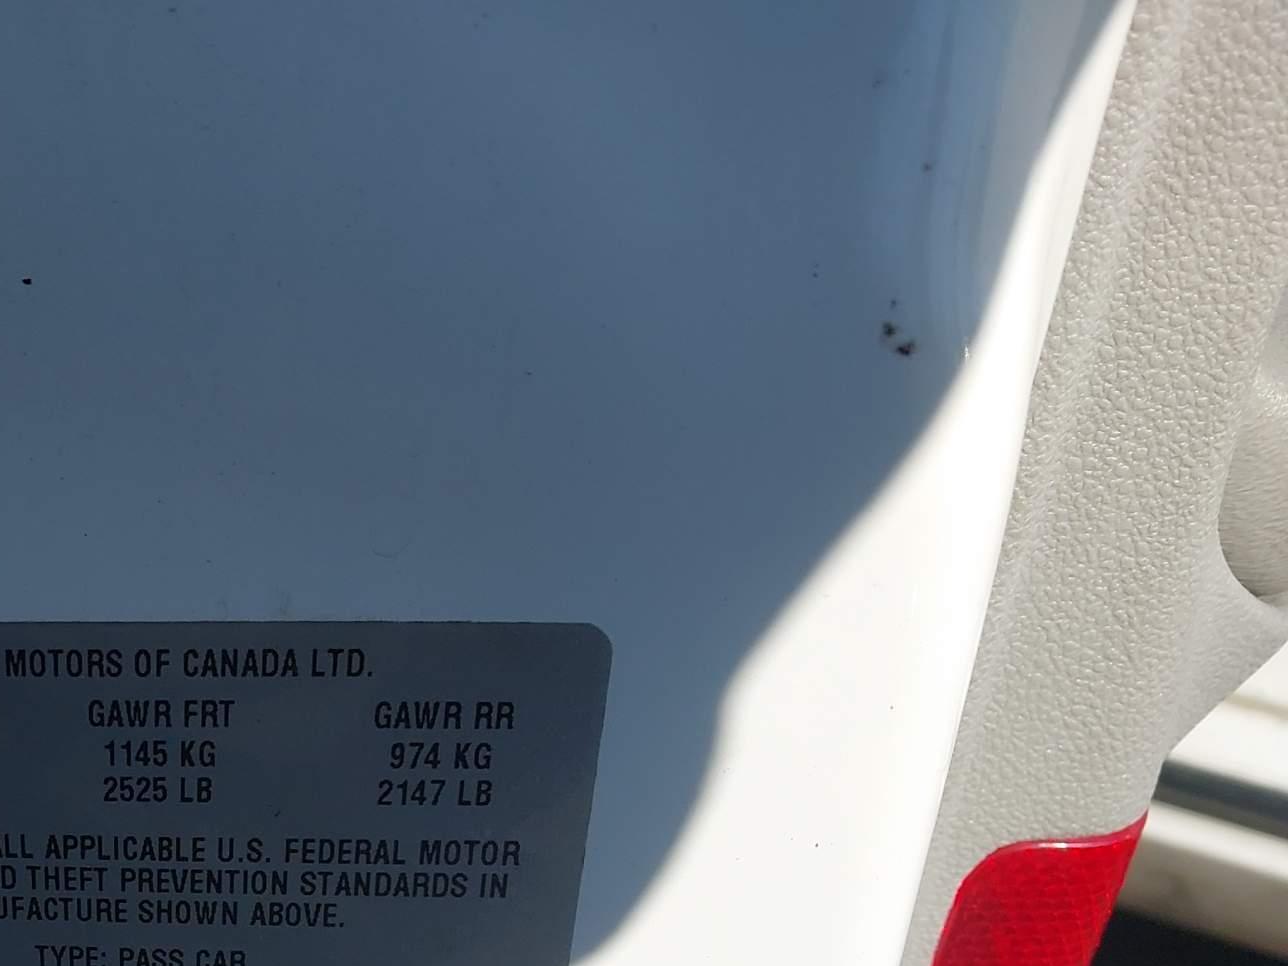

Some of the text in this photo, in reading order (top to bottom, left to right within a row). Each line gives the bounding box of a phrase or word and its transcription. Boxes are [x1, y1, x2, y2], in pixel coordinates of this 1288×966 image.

[5, 648, 123, 678] MOTORS
[134, 649, 171, 677] OF
[183, 649, 299, 677] CANADA
[311, 648, 372, 677] LTD.
[88, 699, 235, 728] GAWR FRT
[374, 701, 514, 730] GAWR RR
[104, 739, 216, 767] 1145 KG
[390, 742, 493, 770] 974 KG
[103, 776, 212, 803] 2525 LB
[377, 779, 492, 806] 2147 LB
[45, 835, 206, 863] APPLICABLE
[217, 837, 270, 863] U.S.
[285, 838, 406, 865] FEDERAL
[419, 840, 521, 866] MOTOR
[26, 866, 108, 892] THEFT
[120, 868, 288, 895] PREVENTION
[300, 871, 468, 897] STANDARDS
[479, 872, 509, 898] IN
[138, 899, 239, 925] SHOWN
[249, 898, 344, 928] ABOVE.
